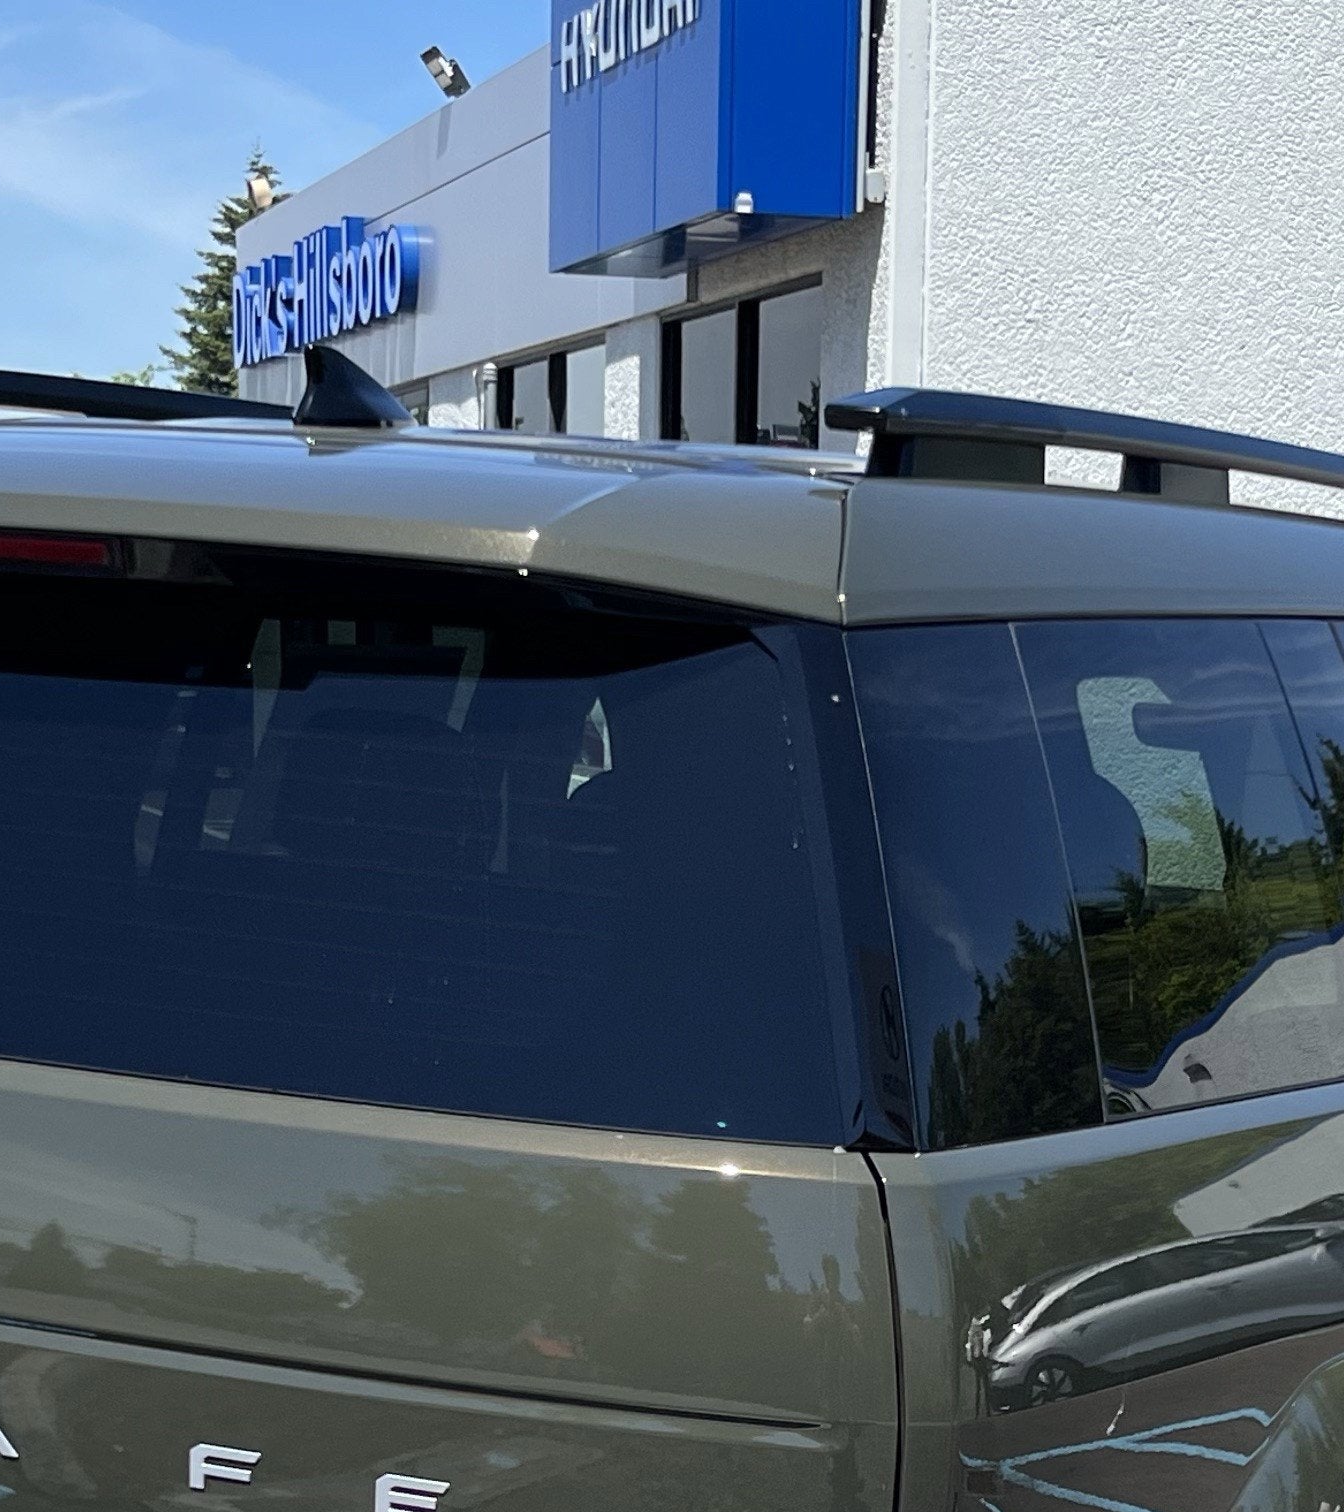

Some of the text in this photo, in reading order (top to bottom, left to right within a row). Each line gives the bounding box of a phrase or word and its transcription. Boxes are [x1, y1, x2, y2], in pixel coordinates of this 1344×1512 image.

[561, 0, 697, 93] HYUND
[233, 217, 402, 370] Dick's Hillsboro
